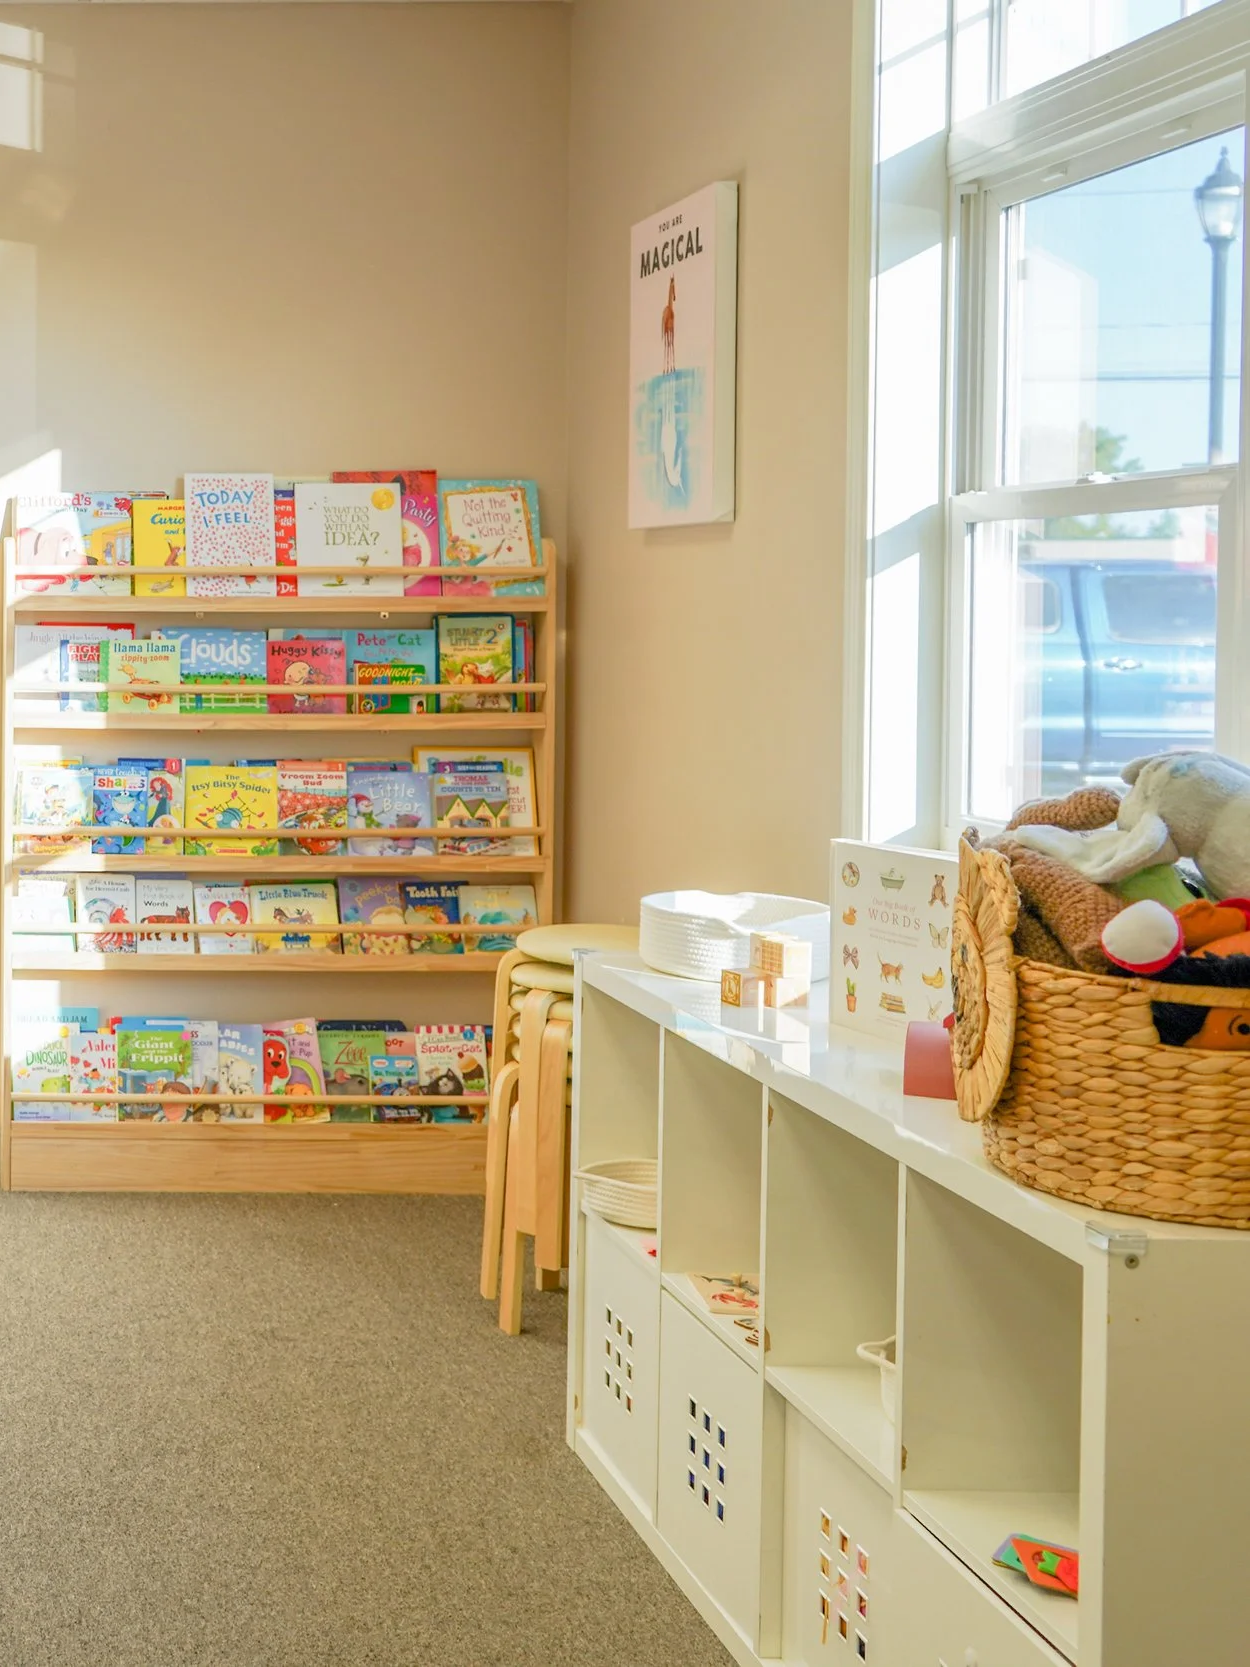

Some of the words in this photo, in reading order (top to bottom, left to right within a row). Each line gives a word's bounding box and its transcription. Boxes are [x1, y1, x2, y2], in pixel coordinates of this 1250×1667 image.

[658, 221, 670, 233] YOU
[672, 214, 683, 227] ARE
[640, 226, 703, 279] MAGICAL
[195, 490, 254, 508] TODAY
[463, 498, 484, 512] Not
[323, 506, 350, 514] WHAT
[353, 506, 369, 514] DO
[403, 498, 436, 527] Party
[150, 513, 186, 525] Curio
[202, 515, 209, 528] I
[214, 511, 250, 526] FEEL
[324, 515, 348, 524] YOU
[351, 515, 369, 523] DO
[462, 511, 511, 527] Quitting
[324, 523, 350, 532] WITH
[354, 523, 369, 531] AN
[478, 523, 505, 538] Kind
[324, 531, 380, 546] IDEA?
[280, 582, 296, 594] Dr.
[446, 627, 485, 637] STUART
[450, 637, 480, 646] LITTLE
[485, 628, 498, 644] 2
[357, 632, 387, 647] Pete
[398, 632, 422, 647] Cat
[114, 643, 143, 653] llama
[146, 643, 176, 653] llama
[271, 645, 308, 658] Huggy
[311, 646, 342, 660] Kissy
[358, 667, 415, 678] GOODNIGHT
[97, 777, 146, 788] shas
[192, 781, 211, 792] Itsy
[212, 780, 238, 789] Bitsy
[239, 781, 272, 794] Spider
[369, 783, 415, 800] Little
[382, 798, 422, 813] Bear
[259, 890, 282, 900] Little
[283, 888, 302, 898] Blue
[303, 888, 327, 899] Truck
[406, 886, 439, 898] Tooth
[440, 886, 460, 898] Fai
[872, 896, 883, 906] Our
[894, 902, 908, 911] Book
[868, 907, 921, 930] WORDS
[70, 1015, 88, 1023] JAM
[218, 1028, 241, 1040] LAR
[134, 1040, 174, 1049] Giant
[219, 1039, 256, 1056] ABIES
[421, 1043, 452, 1054] Splat
[462, 1043, 482, 1053] Cat
[26, 1050, 69, 1067] DINOSAUR
[131, 1053, 184, 1065] Frippit
[299, 1048, 313, 1058] Pup
